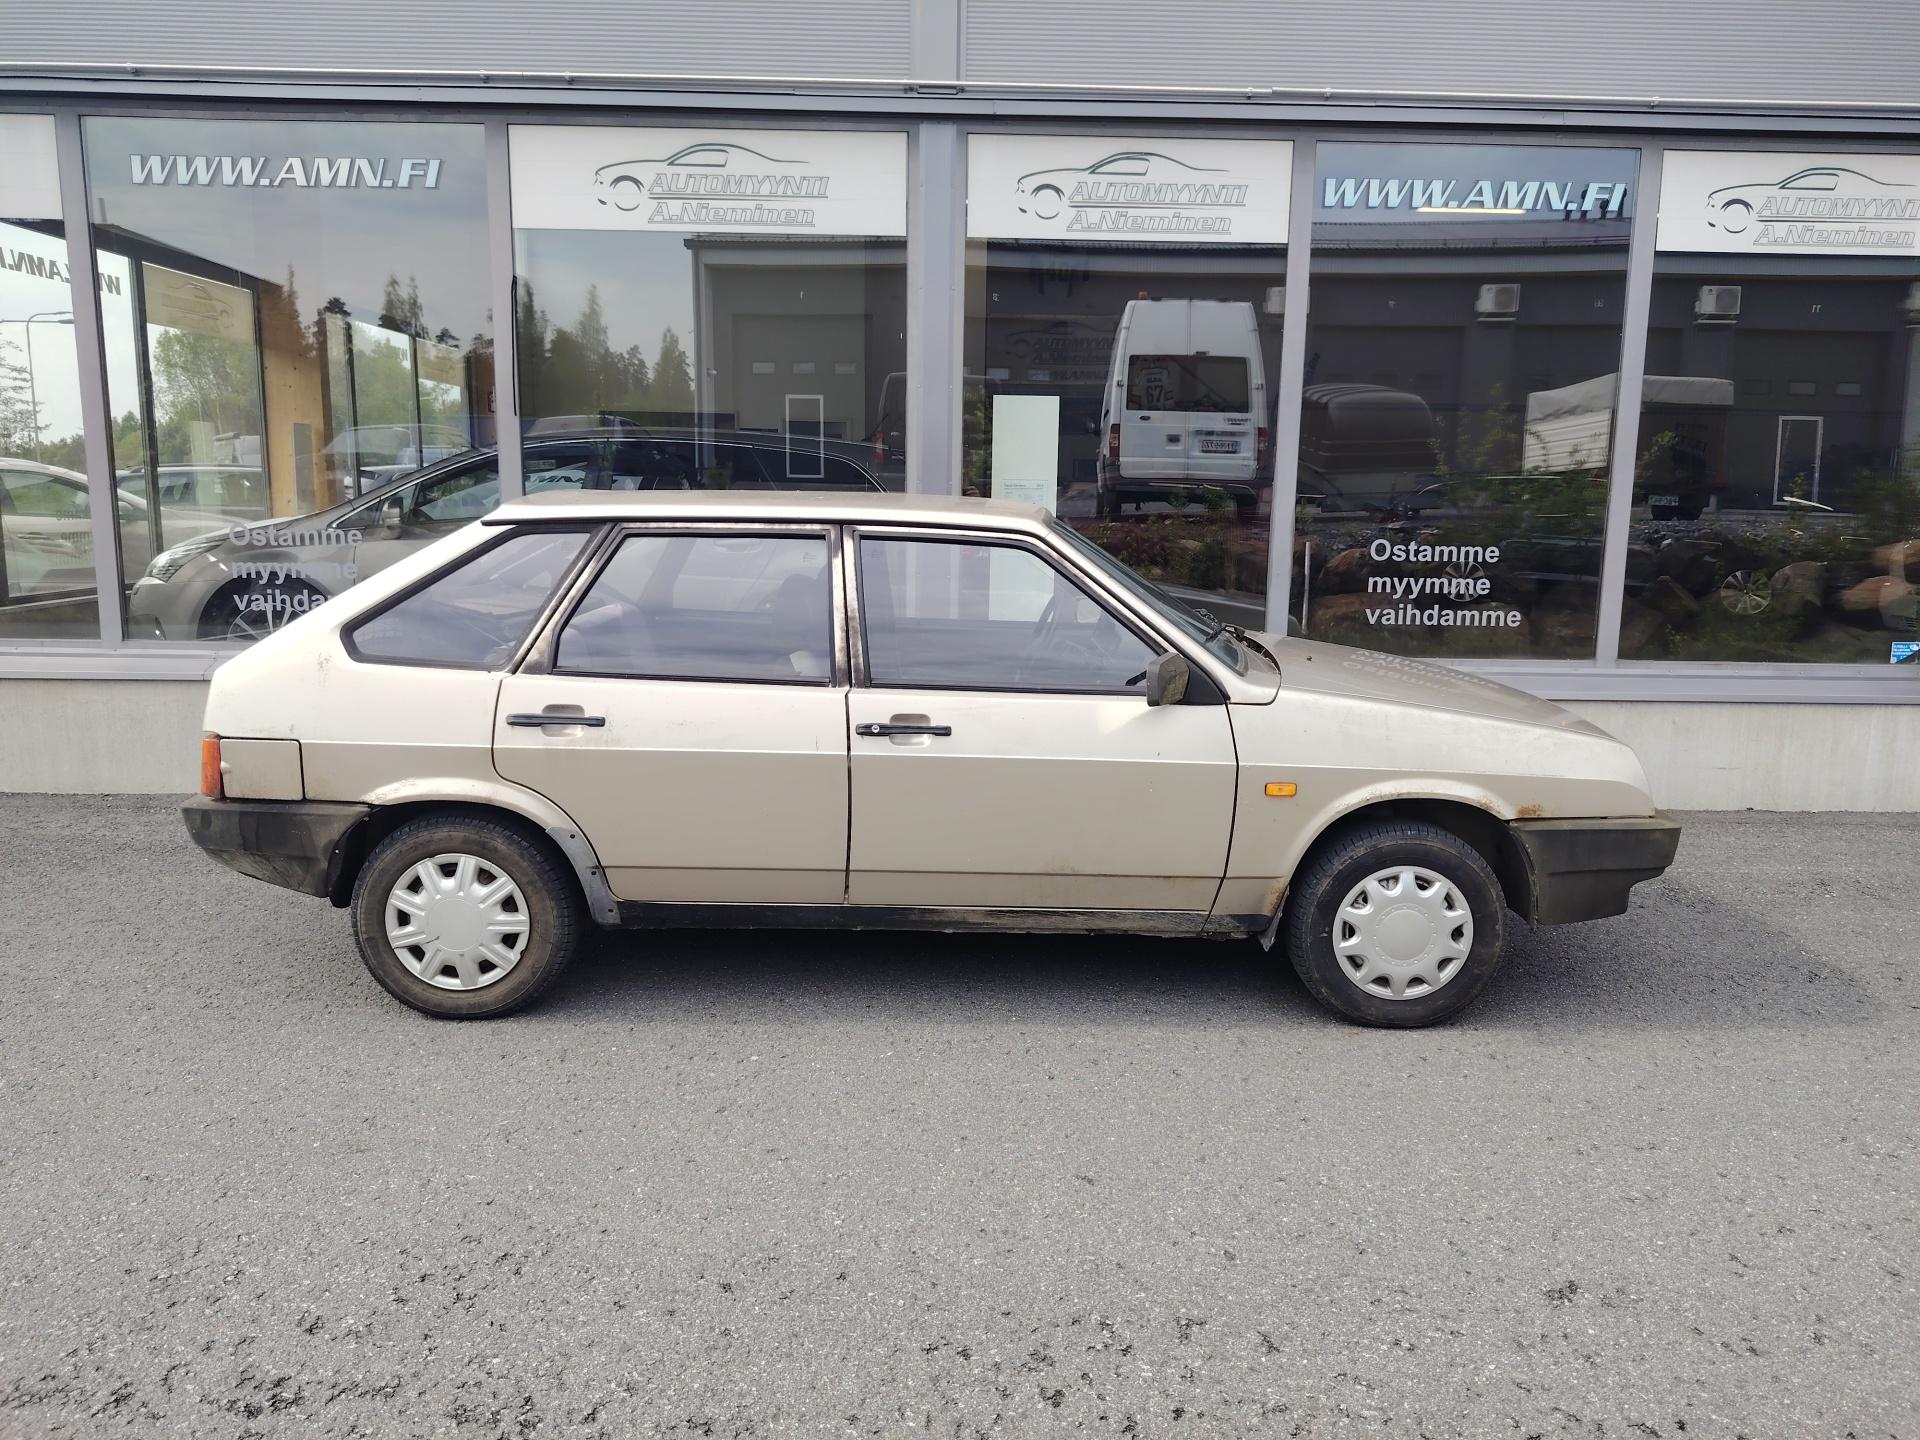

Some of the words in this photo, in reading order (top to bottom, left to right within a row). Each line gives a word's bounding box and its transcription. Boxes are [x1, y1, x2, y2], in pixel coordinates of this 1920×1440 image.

[129, 153, 442, 189] WWW.AMN.FI
[648, 172, 830, 196] AUTOMYYNTI
[1068, 181, 1249, 204] AUTOMYYNTI
[1322, 176, 1628, 213] WWW.AMN.FI
[649, 201, 816, 224] A.Nieminen
[1757, 196, 1920, 218] AUTOMYYNT
[1066, 209, 1232, 233] A.Nieminen
[1753, 224, 1916, 246] A.Nieminen
[229, 525, 364, 547] Ostamme
[1369, 538, 1501, 563] Ostamme
[1367, 575, 1492, 599] myymme
[233, 588, 332, 612] vaihda
[1364, 603, 1523, 628] vaihdamme
